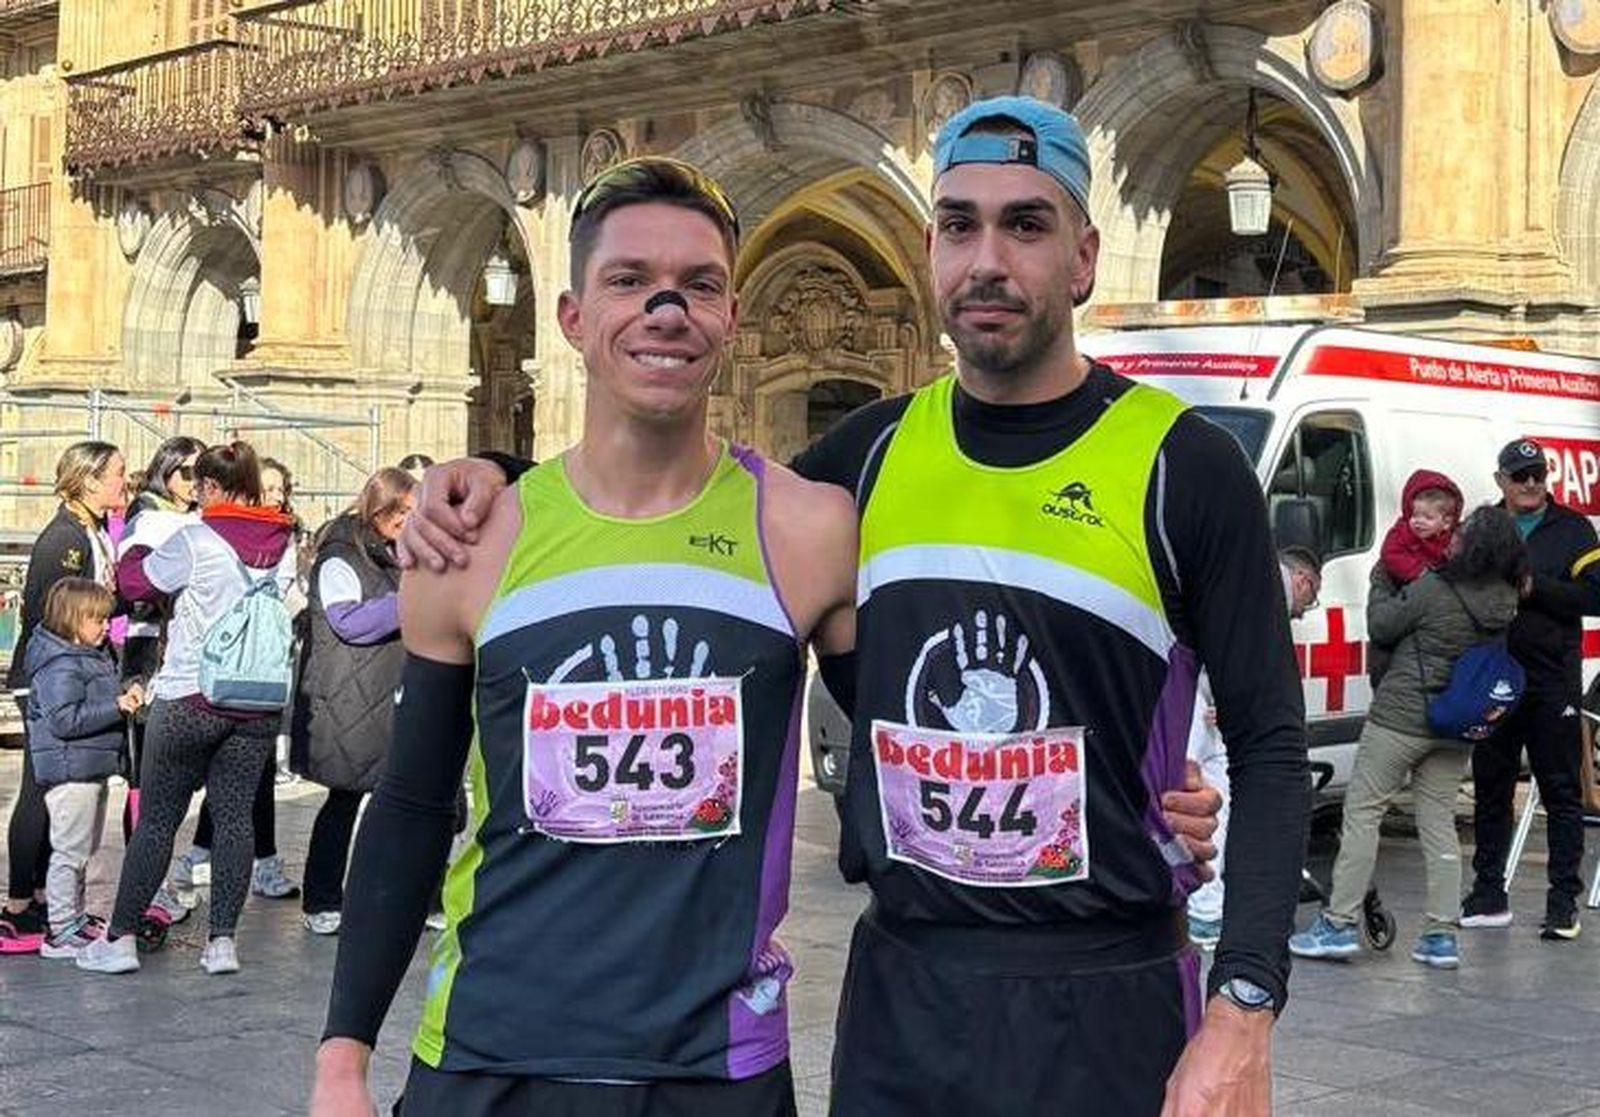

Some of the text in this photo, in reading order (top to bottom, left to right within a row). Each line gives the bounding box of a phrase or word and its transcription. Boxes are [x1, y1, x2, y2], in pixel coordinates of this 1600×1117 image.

[1409, 356, 1447, 381] Punto
[1448, 361, 1465, 381] de
[1466, 363, 1501, 387] Alerta
[1510, 369, 1559, 392] Primeros
[1543, 446, 1600, 505] PAP
[531, 689, 735, 729] bedunia
[574, 732, 696, 793] 543
[876, 730, 1079, 781] bedunia
[920, 780, 1038, 840] 544
